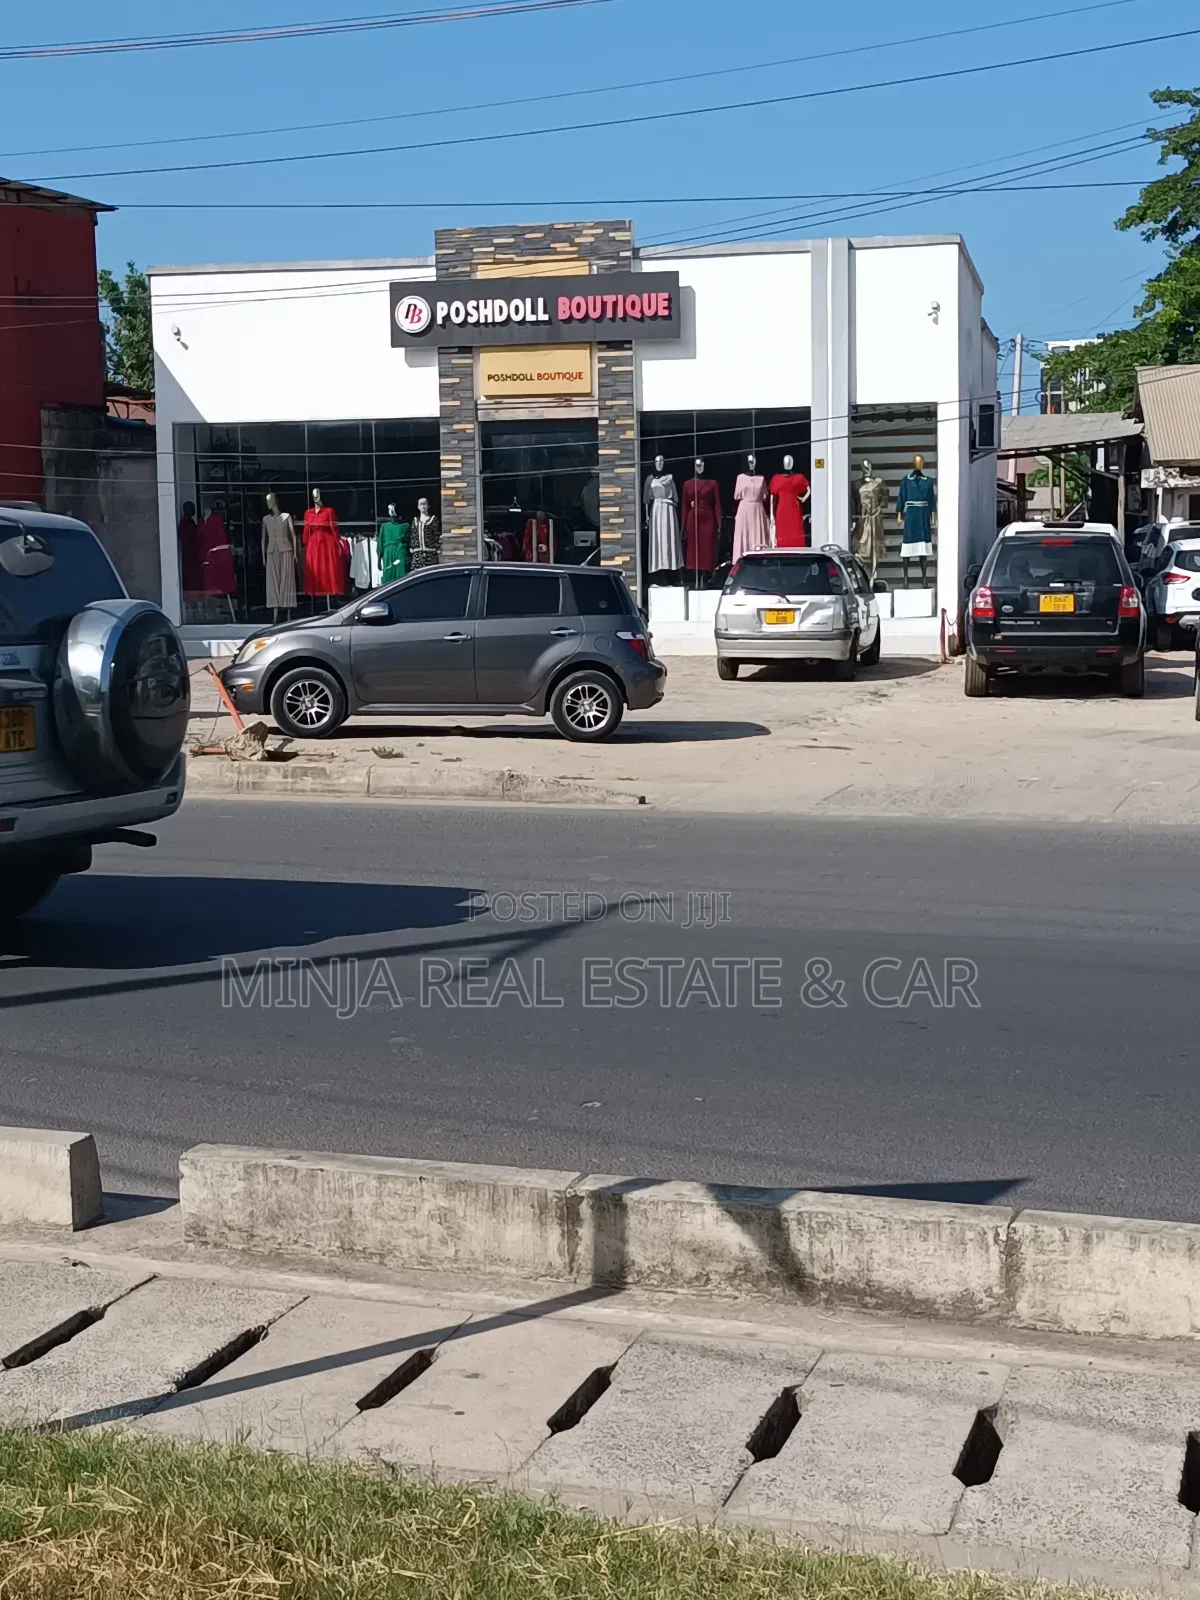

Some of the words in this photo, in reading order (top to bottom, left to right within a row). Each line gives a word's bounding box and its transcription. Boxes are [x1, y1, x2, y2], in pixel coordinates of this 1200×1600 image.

[436, 297, 550, 325] POSHDOLL
[557, 292, 670, 321] BOUTIQUE
[487, 373, 535, 382] POSHDOLL
[536, 372, 584, 382] BOUTIQUE
